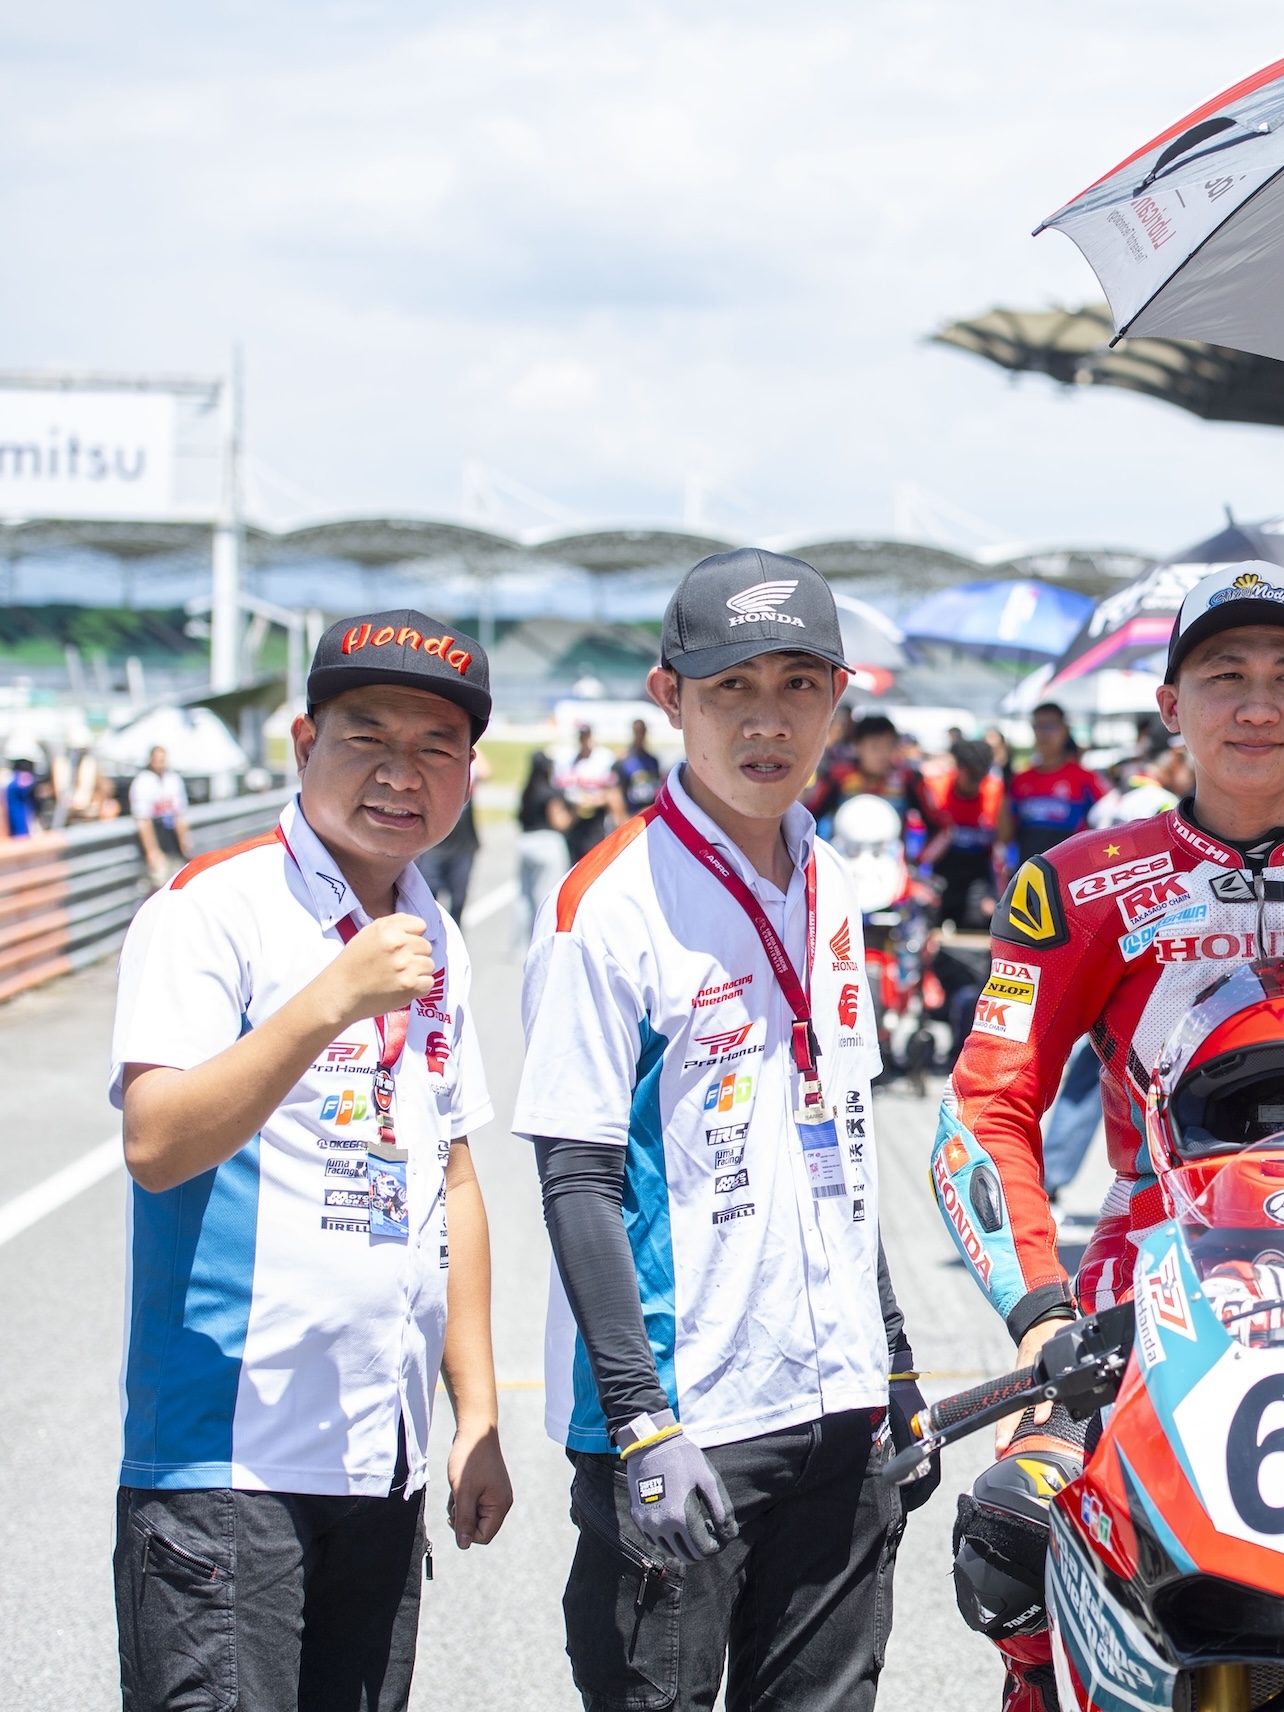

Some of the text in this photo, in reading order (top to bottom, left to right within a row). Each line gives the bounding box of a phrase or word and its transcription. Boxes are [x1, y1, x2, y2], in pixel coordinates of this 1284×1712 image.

[728, 612, 806, 629] HONDA
[341, 623, 473, 676] Honda
[1172, 816, 1231, 864] TAICHI
[706, 855, 730, 878] ARRC
[1111, 857, 1168, 885] RCB
[1122, 875, 1188, 919] RK
[1130, 893, 1191, 926] TAKASAGO CHAIN
[1141, 904, 1207, 944] OKGAWA
[832, 962, 858, 972] HONDA
[723, 974, 753, 991] Racing
[988, 982, 1029, 996] NLOP
[327, 1166, 355, 1177] racing
[328, 1159, 350, 1168] uma
[712, 1202, 756, 1225] PIRELLI
[934, 1154, 991, 1290] HONDA
[1003, 1605, 1042, 1629] TAICHI
[1060, 1552, 1138, 1690] Vietnam
[1080, 1570, 1153, 1687] Racing
